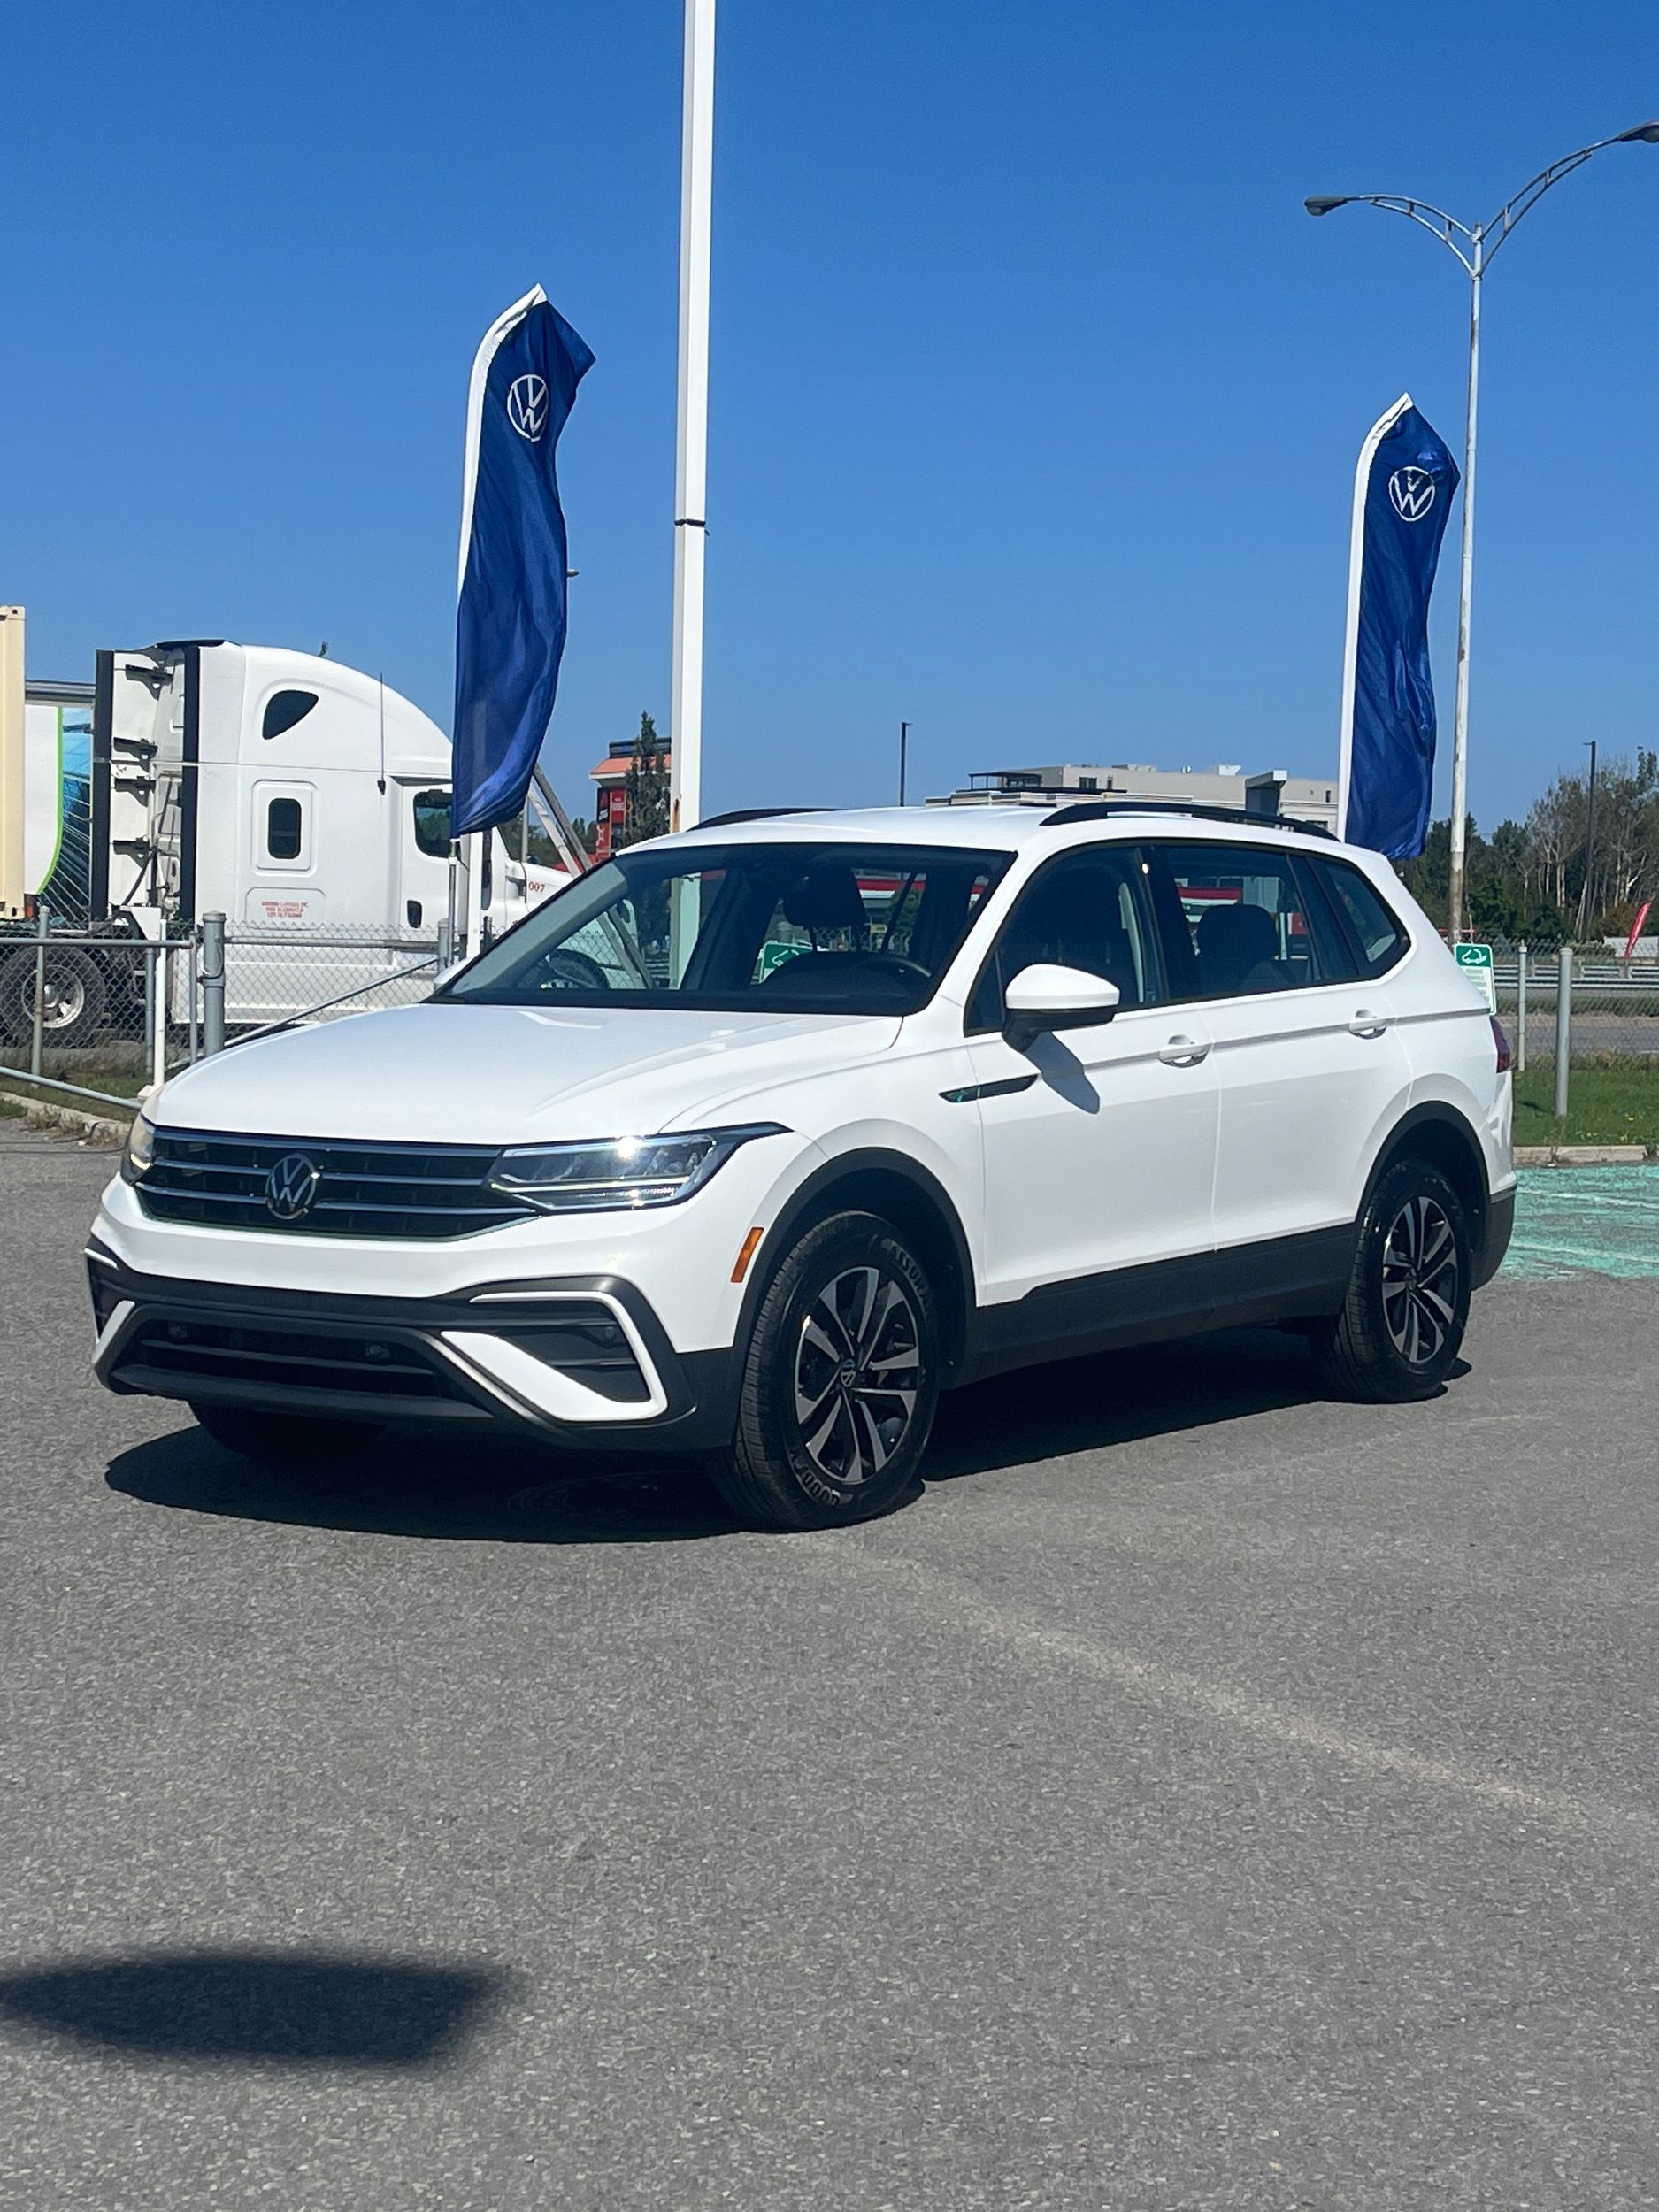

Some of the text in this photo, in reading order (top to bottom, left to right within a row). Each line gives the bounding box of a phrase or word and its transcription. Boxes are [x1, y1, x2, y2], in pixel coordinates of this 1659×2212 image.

[508, 374, 549, 442] VW
[1389, 466, 1435, 521] VW
[528, 882, 545, 893] 007
[267, 1154, 316, 1217] VW
